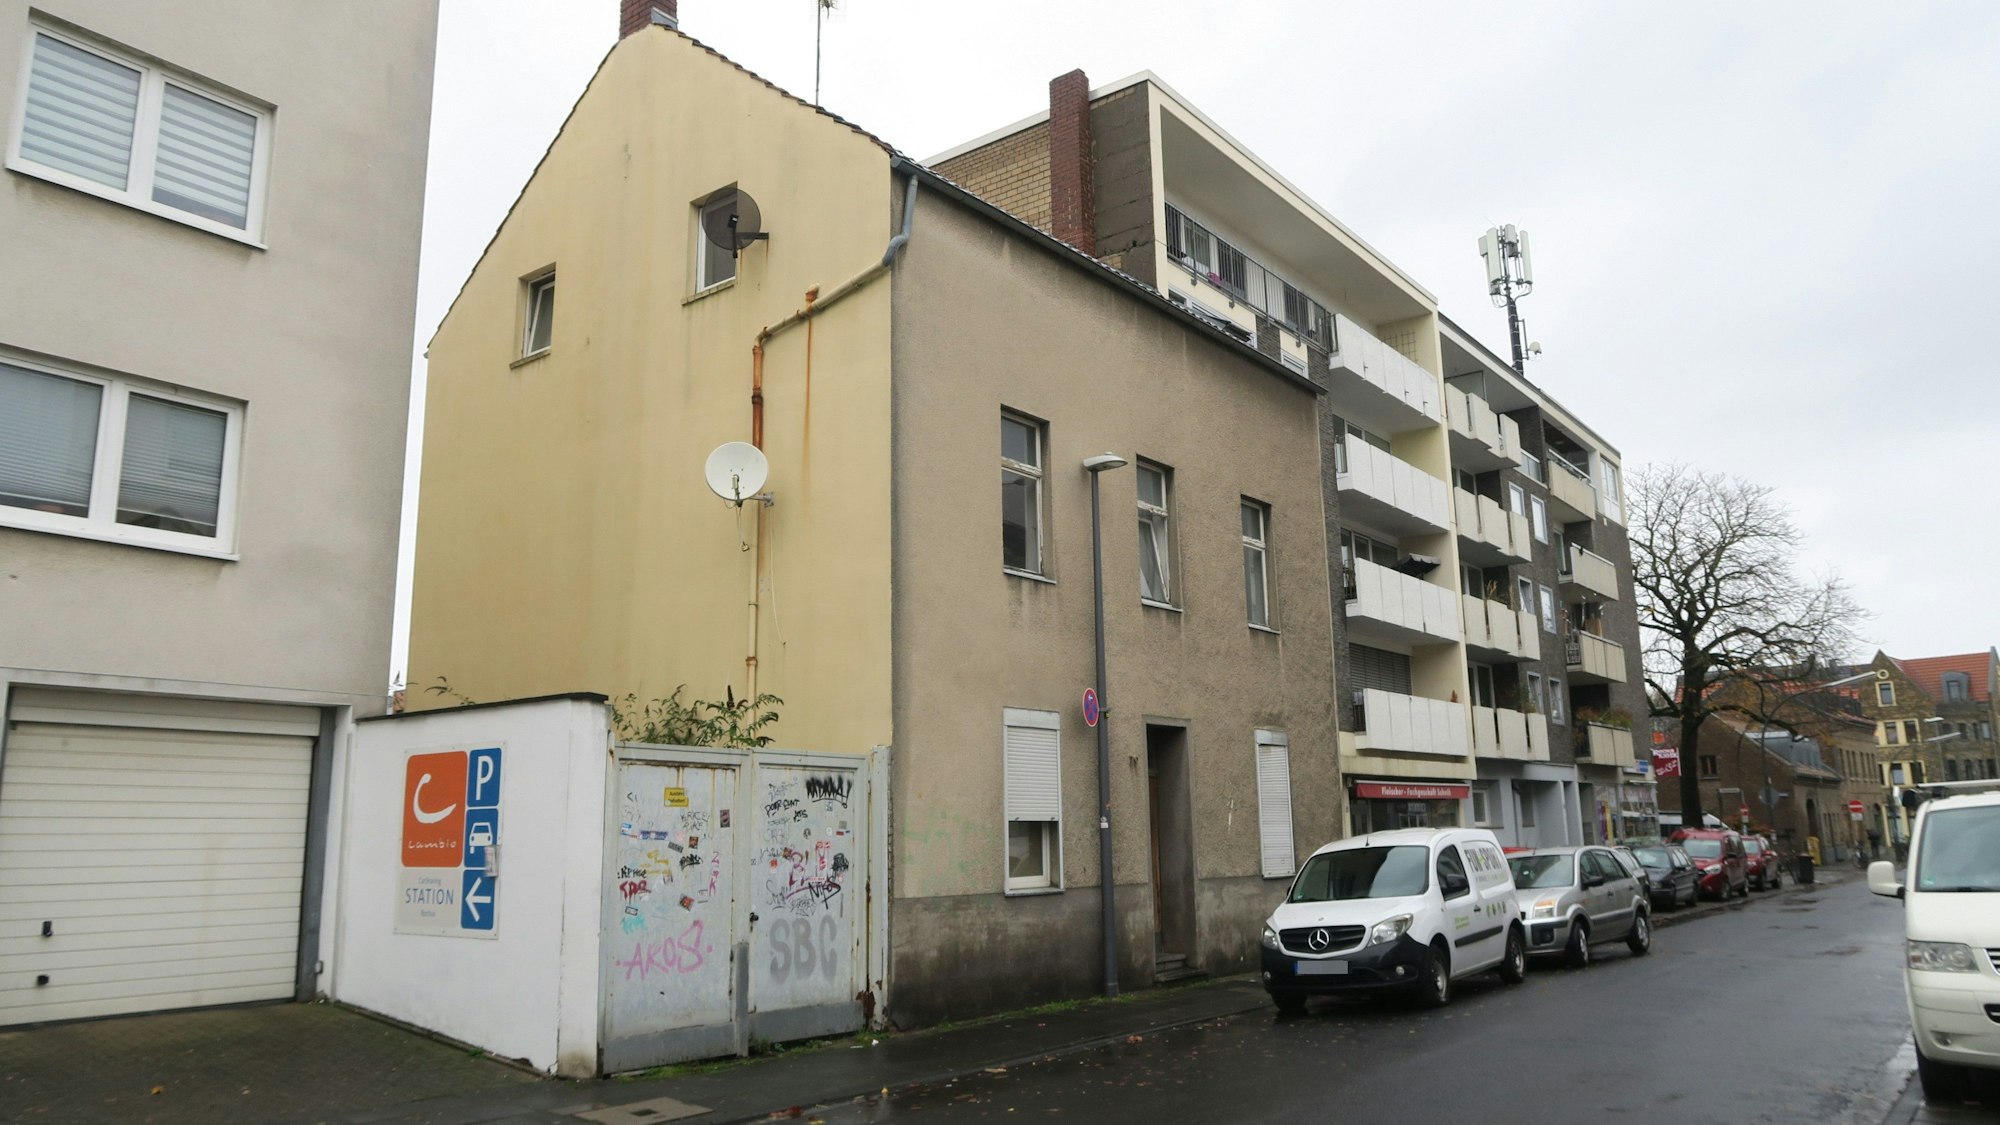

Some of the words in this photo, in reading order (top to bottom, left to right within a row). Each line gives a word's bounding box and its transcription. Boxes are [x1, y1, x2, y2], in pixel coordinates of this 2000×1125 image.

[476, 755, 494, 801] P
[408, 838, 457, 849] cambio
[406, 887, 454, 905] STATION
[621, 919, 704, 981] AKOS
[769, 914, 838, 985] SBC
